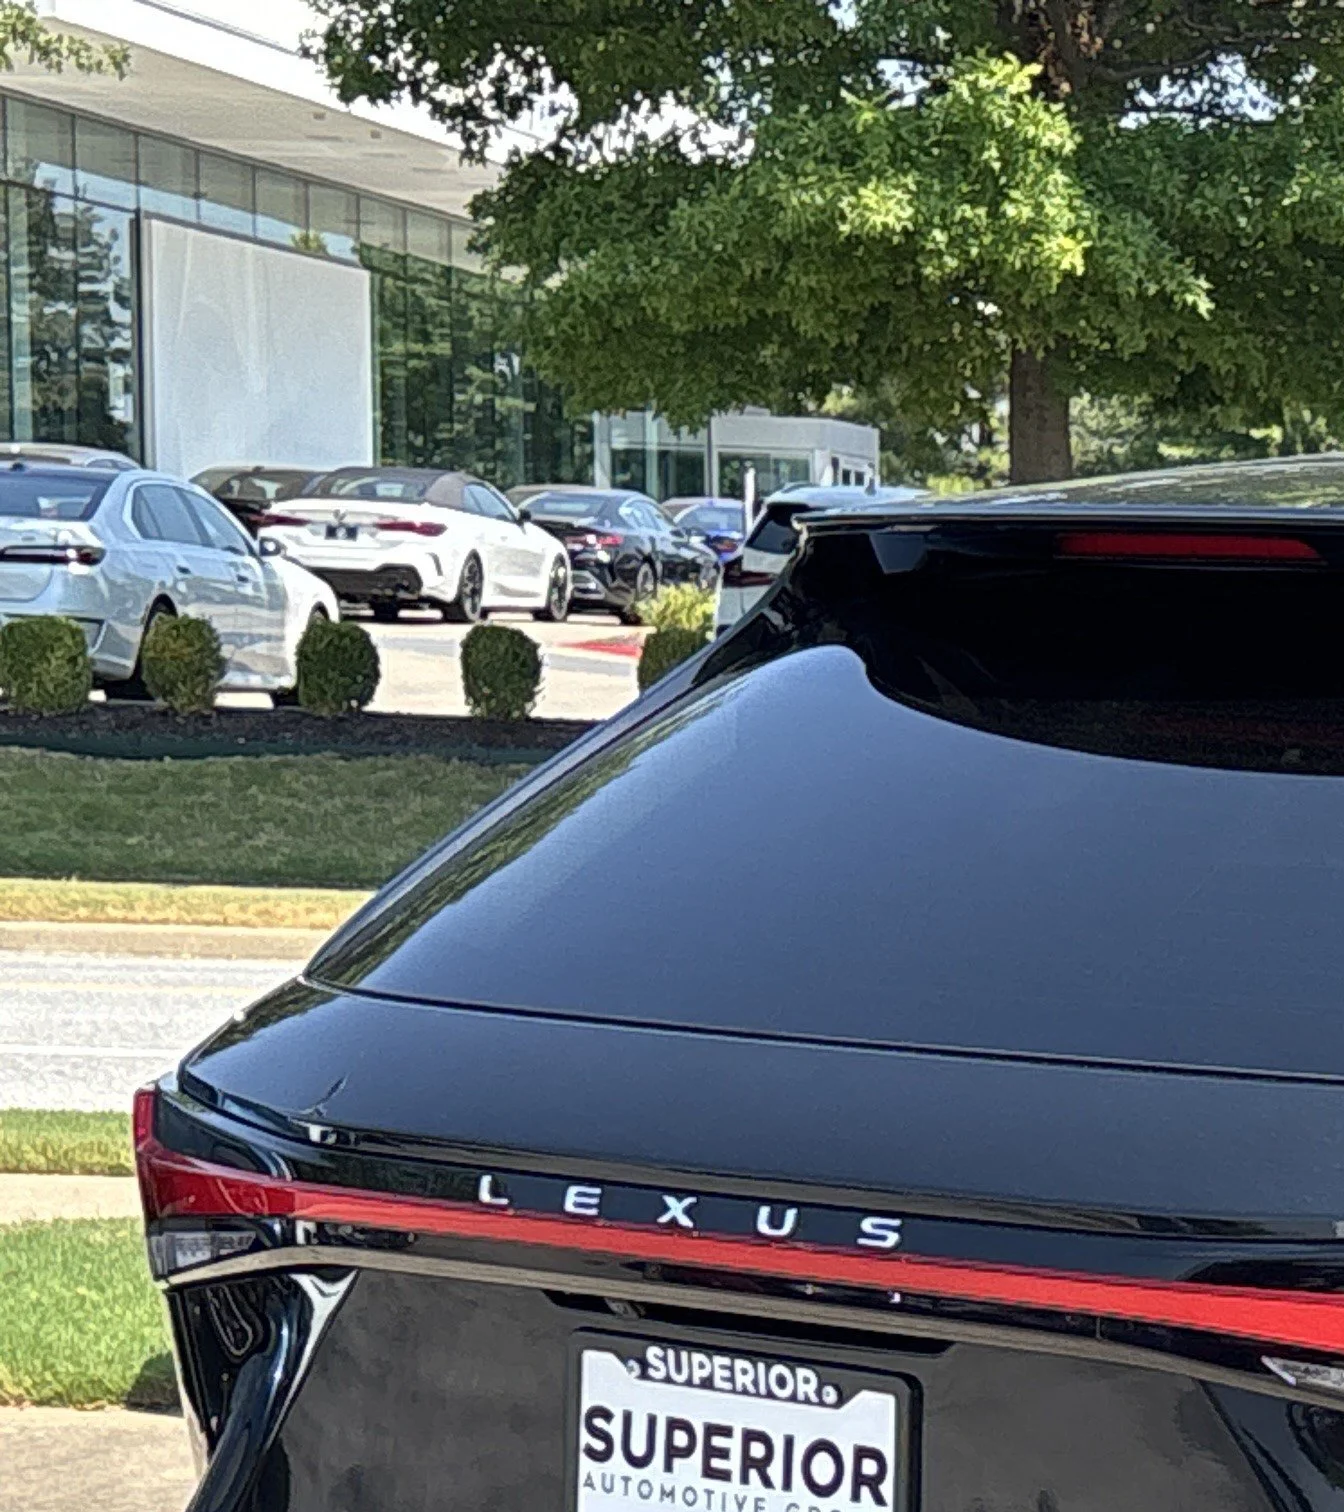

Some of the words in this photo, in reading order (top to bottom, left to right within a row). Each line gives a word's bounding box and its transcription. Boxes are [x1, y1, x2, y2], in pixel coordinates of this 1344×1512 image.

[478, 1174, 902, 1248] LEXUS
[645, 1346, 820, 1404] SUPERIOR
[582, 1405, 889, 1507] SUPERIOR
